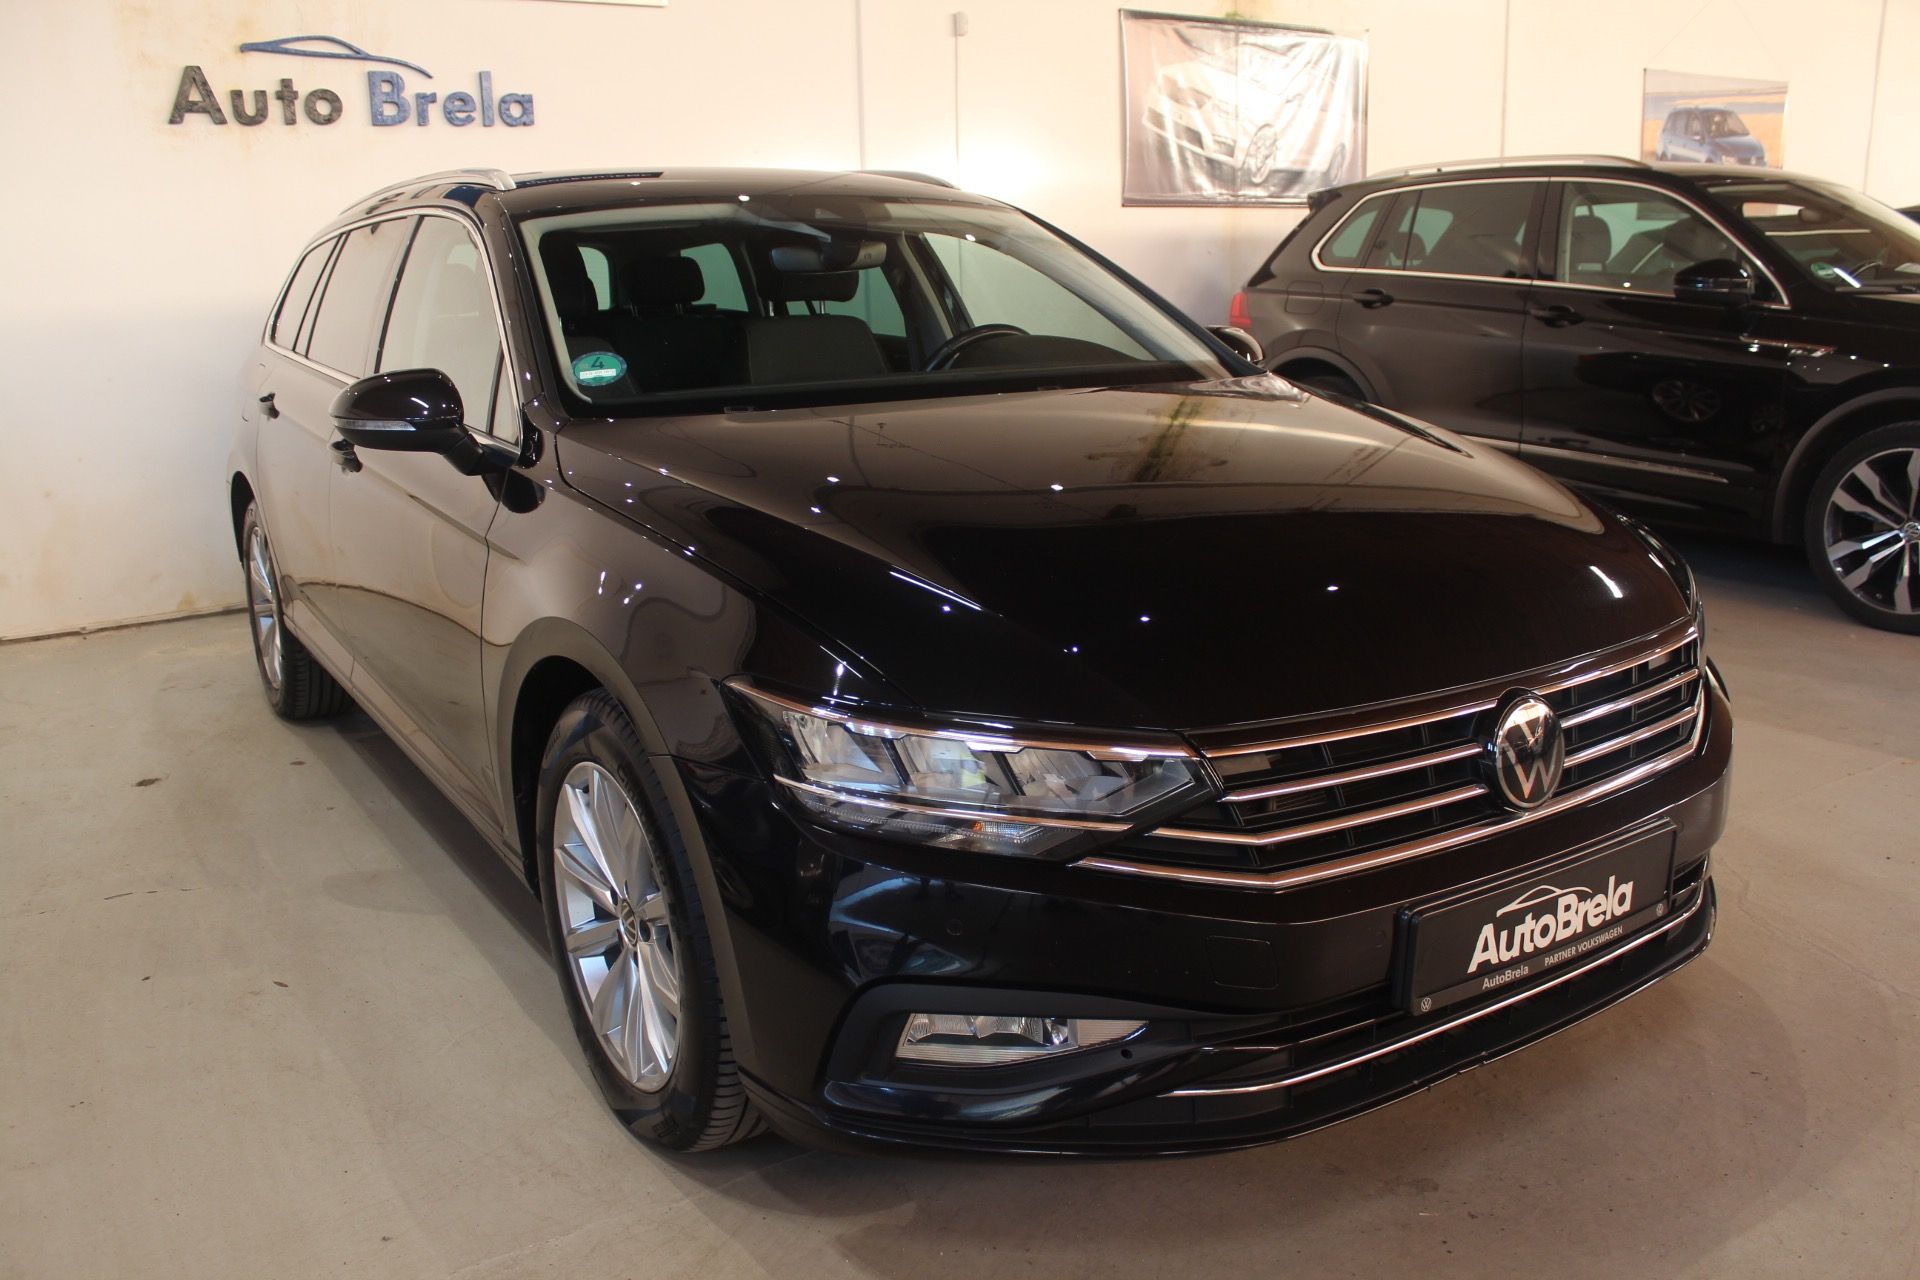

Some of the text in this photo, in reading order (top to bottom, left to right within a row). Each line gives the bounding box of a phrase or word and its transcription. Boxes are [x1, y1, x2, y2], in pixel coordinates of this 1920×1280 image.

[168, 65, 536, 128] Auto Brela
[590, 356, 605, 369] 4
[1467, 874, 1634, 974] AutoBrela
[1544, 925, 1624, 967] PARTNER VOLKSWAGEN
[1482, 964, 1529, 990] AutoBrela
